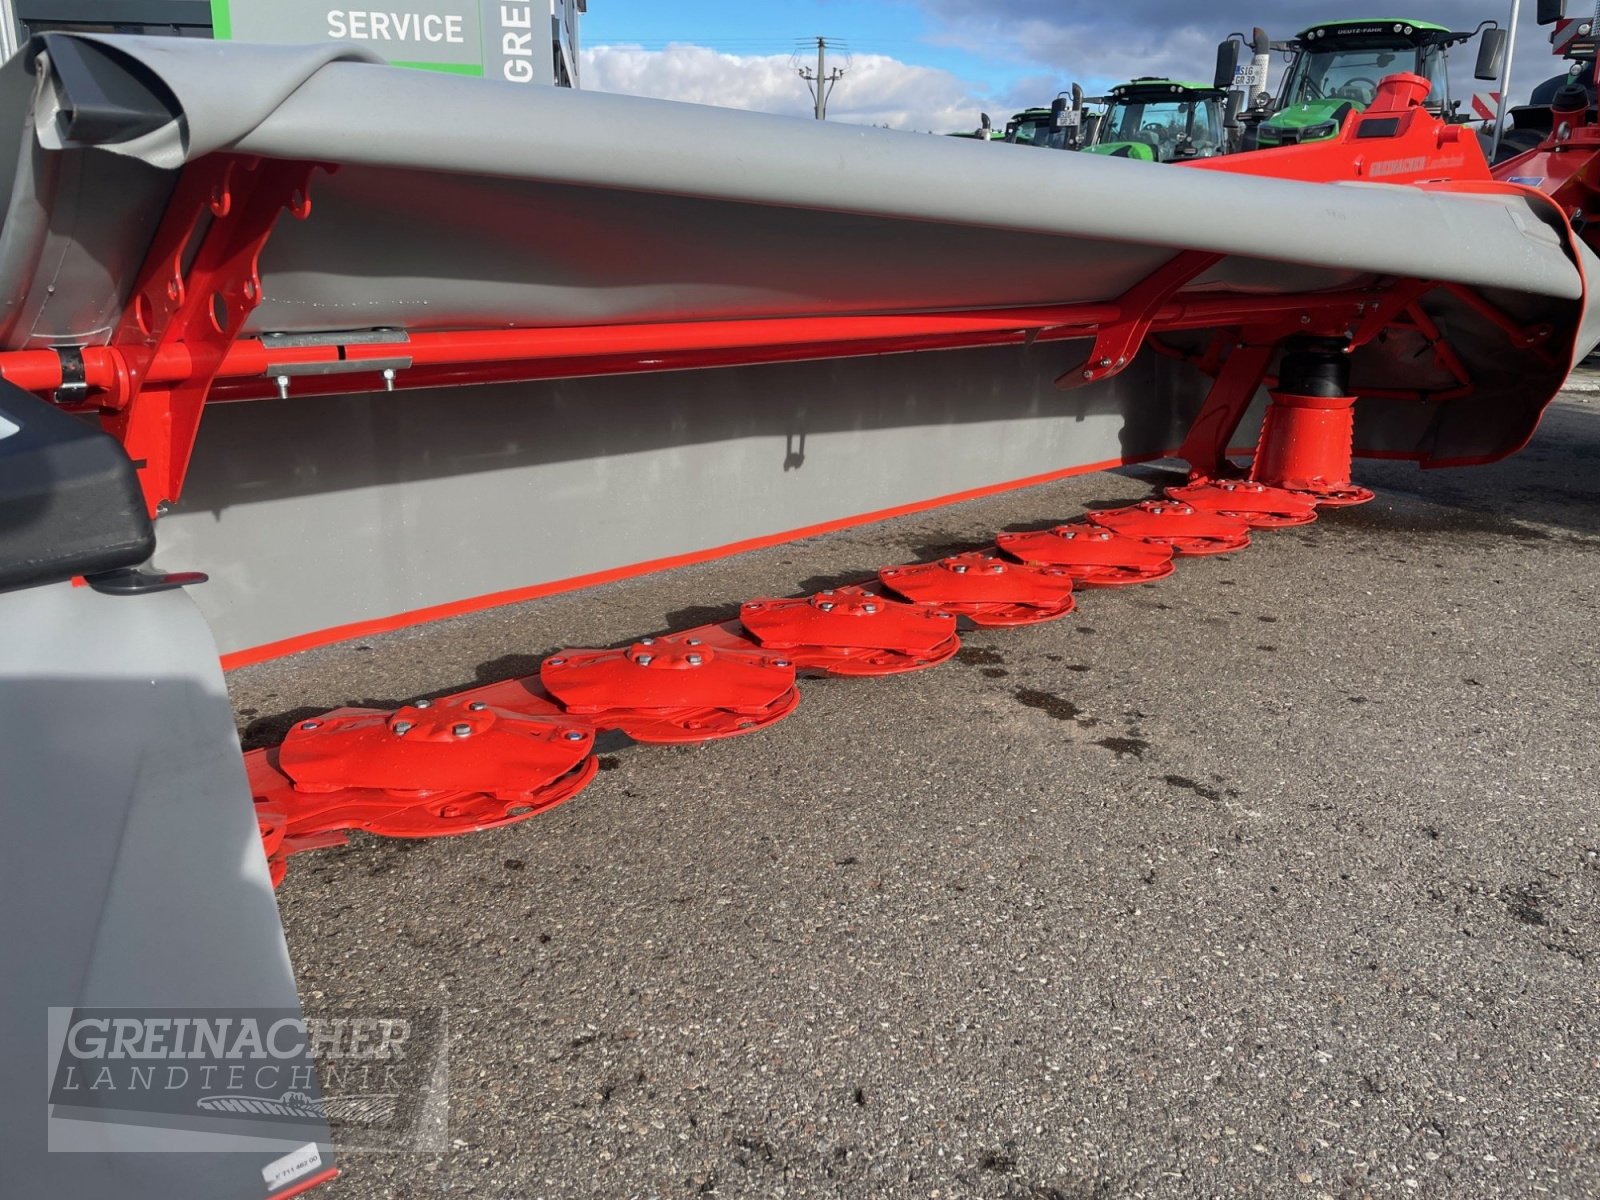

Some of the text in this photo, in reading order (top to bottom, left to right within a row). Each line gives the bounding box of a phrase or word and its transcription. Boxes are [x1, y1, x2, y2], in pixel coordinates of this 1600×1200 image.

[327, 9, 464, 43] SERVICE
[1240, 66, 1254, 76] SIG
[1246, 75, 1256, 85] 39
